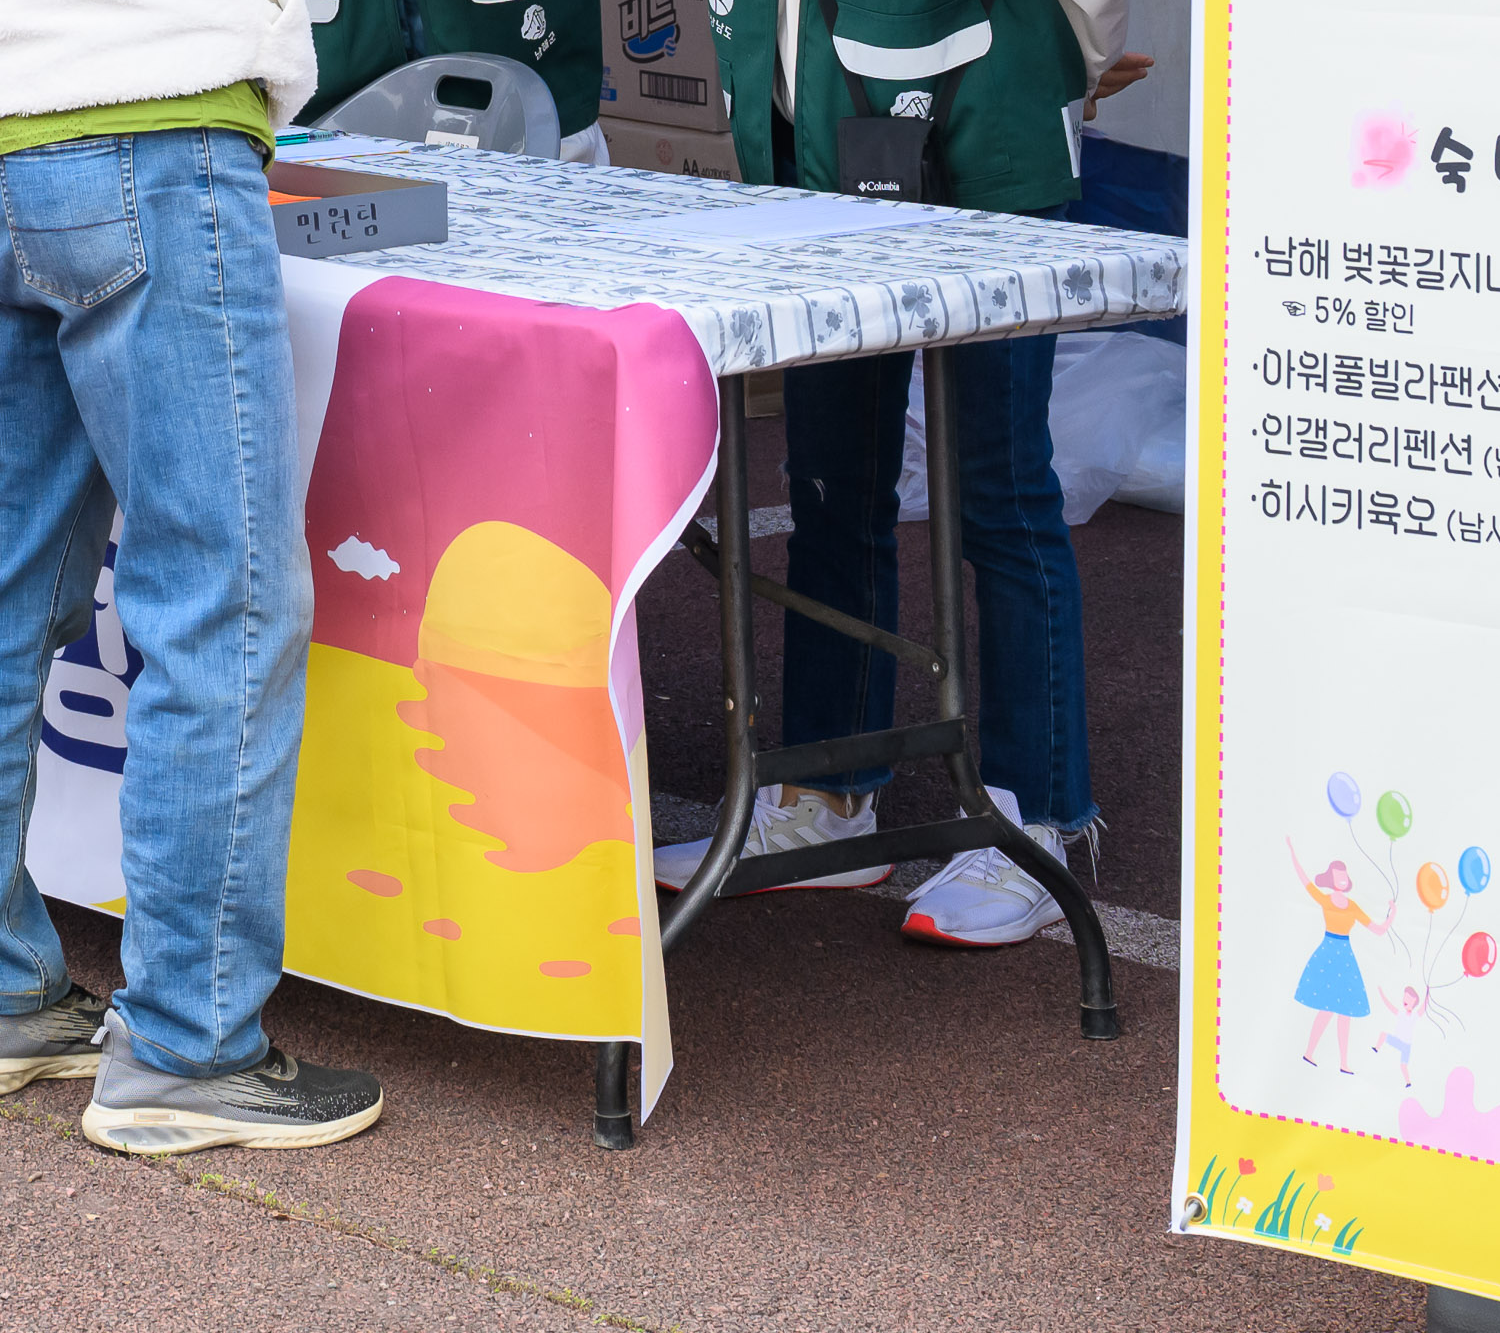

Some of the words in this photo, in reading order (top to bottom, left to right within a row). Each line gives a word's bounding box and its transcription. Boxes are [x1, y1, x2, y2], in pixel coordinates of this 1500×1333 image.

[533, 29, 557, 61] 남해군
[867, 178, 900, 193] Columbia
[295, 200, 381, 245] 민원팀
[1315, 296, 1356, 326] 5%
[1364, 299, 1414, 335] 할인
